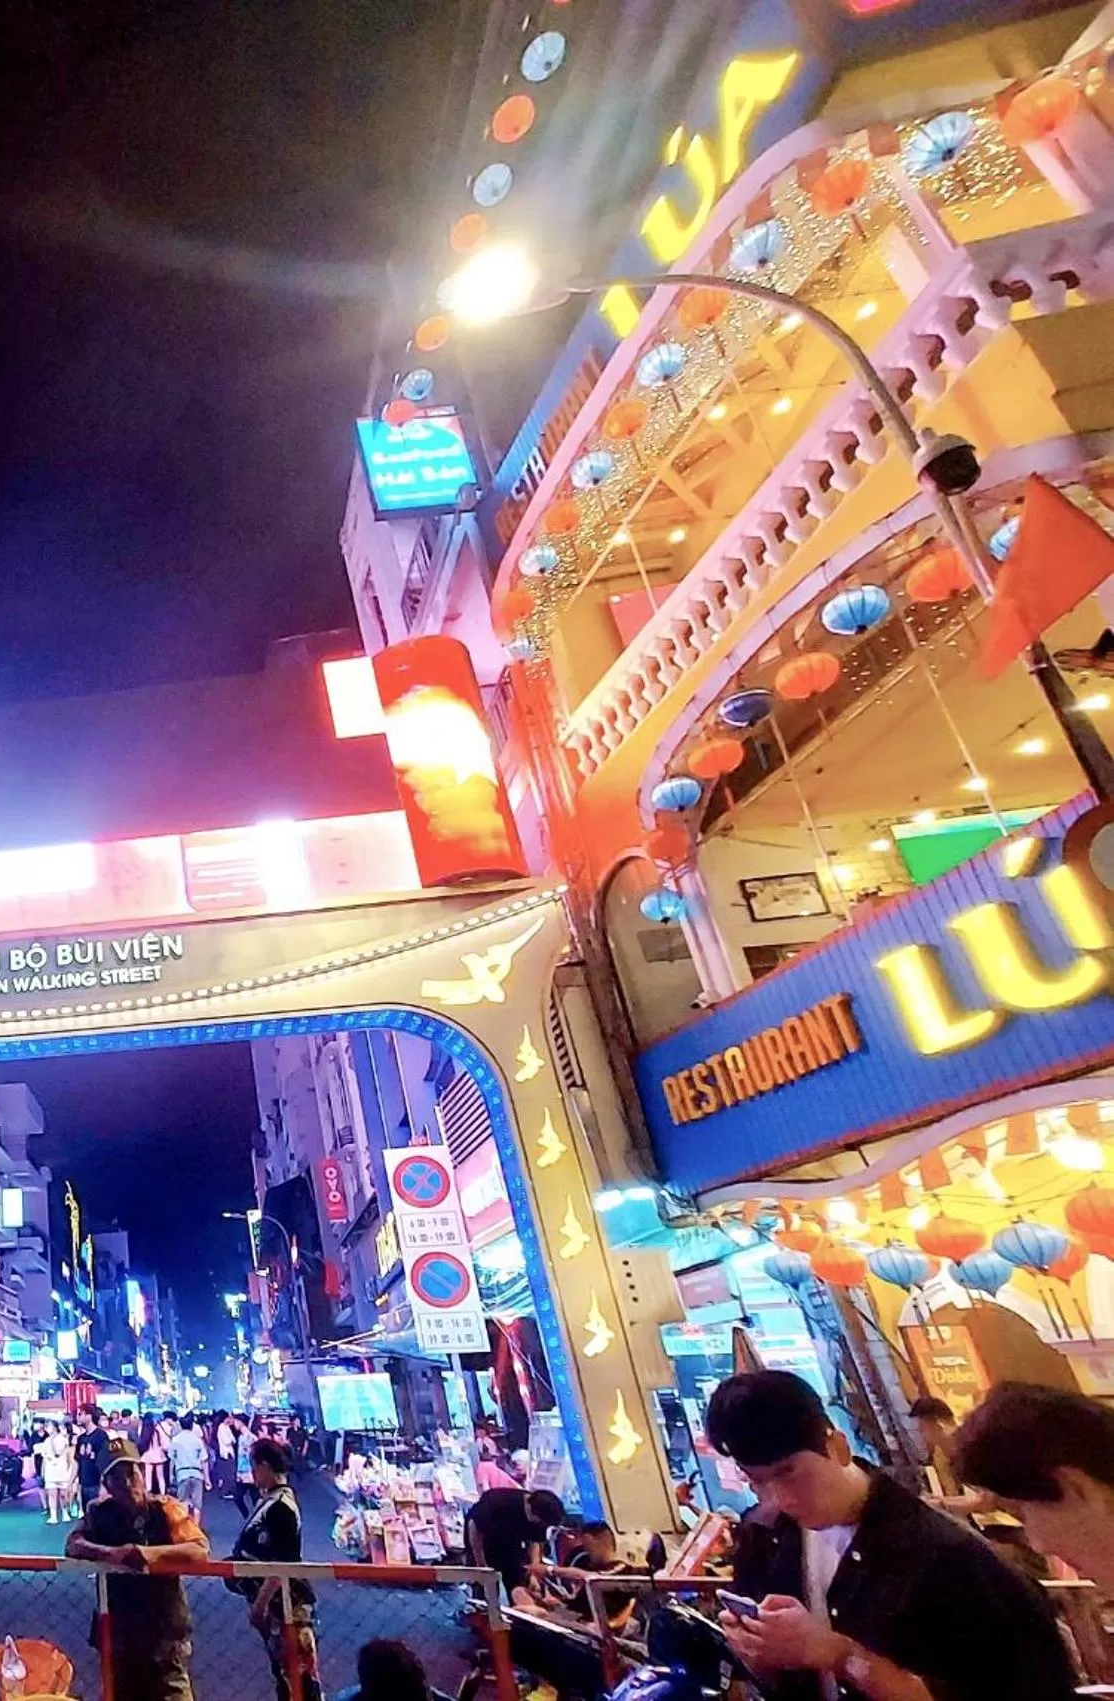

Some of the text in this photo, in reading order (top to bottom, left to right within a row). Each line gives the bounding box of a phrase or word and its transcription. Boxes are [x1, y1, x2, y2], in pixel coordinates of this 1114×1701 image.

[9, 942, 47, 972] BỘ
[56, 938, 104, 966] BÙI
[112, 932, 184, 962] VIỆN
[12, 970, 97, 993] WALKING
[100, 965, 162, 986] STREET
[661, 991, 862, 1126] RESTAURANT
